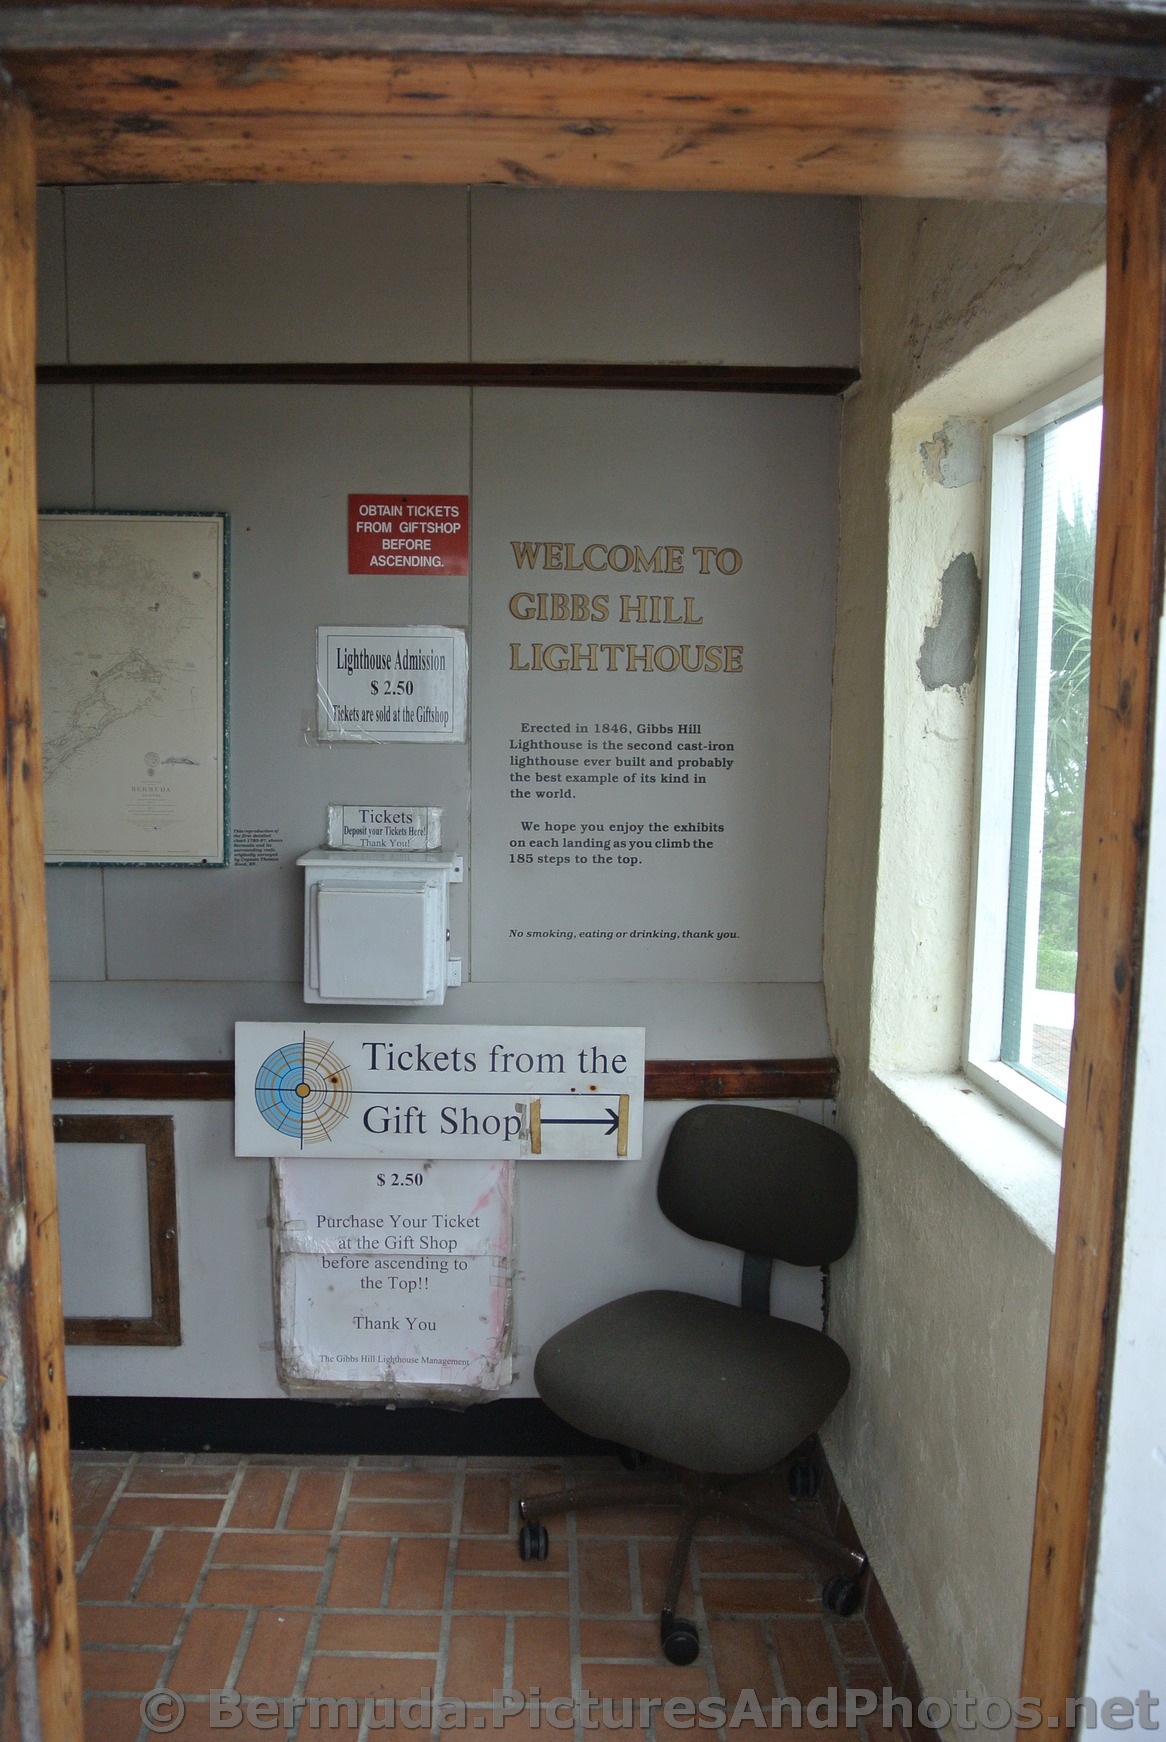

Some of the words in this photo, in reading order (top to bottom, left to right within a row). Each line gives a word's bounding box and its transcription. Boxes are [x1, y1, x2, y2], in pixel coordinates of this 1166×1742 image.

[358, 504, 403, 518] OBTAIN
[407, 505, 459, 518] TICKETS
[356, 521, 392, 534] FROM
[399, 521, 461, 535] GIFTSHOP
[382, 538, 431, 551] BEFORE
[369, 555, 445, 568] ASCENDING.
[510, 541, 684, 574] WELCOME
[693, 547, 743, 575] TO
[509, 592, 609, 622] GIBBS
[619, 595, 703, 624] HILL
[336, 647, 392, 676] Lighthouse
[394, 648, 446, 671] Admission
[509, 642, 744, 673] LIGHTHOUSE
[370, 680, 379, 696] $
[384, 680, 414, 695] 2.50
[332, 704, 360, 722] Tickets
[361, 708, 374, 722] are
[376, 705, 391, 722] sold
[393, 709, 400, 722] at
[402, 706, 415, 723] the
[416, 705, 449, 728] Giftshop
[521, 723, 571, 734] Erected
[576, 723, 588, 733] in
[594, 723, 632, 735] 1846,
[637, 724, 673, 735] Gibbs
[678, 724, 701, 734] Hill
[510, 739, 582, 752] Lighthouse
[587, 740, 598, 750] is
[603, 740, 623, 750] the
[627, 741, 672, 751] second
[677, 741, 734, 751] cast-iron
[510, 755, 579, 768] lighthouse
[584, 759, 611, 767] ever
[615, 757, 646, 766] built
[649, 757, 673, 767] and
[677, 757, 734, 770] probably
[510, 772, 531, 782] the
[535, 772, 562, 782] best
[566, 773, 618, 785] example
[623, 773, 637, 783] of
[640, 773, 656, 783] its
[660, 773, 689, 783] kind
[694, 774, 707, 784] in
[510, 788, 531, 798] the
[535, 789, 576, 798] world.
[358, 809, 413, 824] Tickets
[344, 825, 367, 837] Deposit
[368, 828, 382, 838] your
[384, 826, 407, 836] Tickets
[408, 826, 427, 836] Here!
[521, 821, 541, 831] We
[545, 822, 576, 834] hope
[581, 824, 604, 834] you
[609, 822, 644, 834] enjoy
[648, 822, 669, 832] the
[674, 822, 724, 833] exhibits
[360, 838, 386, 847] Thank
[389, 839, 411, 847] You!
[510, 840, 526, 848] on
[529, 838, 559, 848] each
[563, 838, 611, 851] landing
[629, 841, 652, 851] you
[655, 838, 690, 848] climb
[693, 839, 714, 849] the
[510, 853, 533, 863] 185
[537, 854, 570, 866] steps
[575, 855, 587, 864] to
[592, 854, 613, 864] the
[617, 855, 643, 867] top.
[509, 929, 524, 938] No
[526, 929, 576, 940] smoking,
[579, 930, 613, 940] eating
[630, 930, 680, 940] drinking,
[682, 930, 714, 939] thank
[716, 932, 740, 941] you.
[362, 1042, 477, 1073] Tickets
[488, 1044, 566, 1074] from
[577, 1046, 628, 1074] the
[362, 1105, 428, 1135] Gift
[440, 1107, 522, 1141] Shop
[376, 1173, 386, 1187] $
[391, 1173, 423, 1187] 2.50
[316, 1214, 384, 1228] Purchase
[389, 1215, 428, 1228] Your
[432, 1214, 480, 1228] Ticket
[338, 1239, 352, 1249] at
[357, 1236, 379, 1249] the
[384, 1235, 415, 1249] Gift
[419, 1236, 458, 1253] Shop
[322, 1256, 369, 1269] before
[374, 1257, 449, 1273] ascending
[454, 1257, 468, 1271] to
[360, 1276, 383, 1289] the
[388, 1276, 429, 1293] Top!!
[354, 1316, 400, 1330] Thank
[405, 1317, 437, 1331] You
[336, 1355, 358, 1363] Gibbs
[378, 1355, 419, 1365] Lighthouse
[421, 1356, 470, 1367] Management
